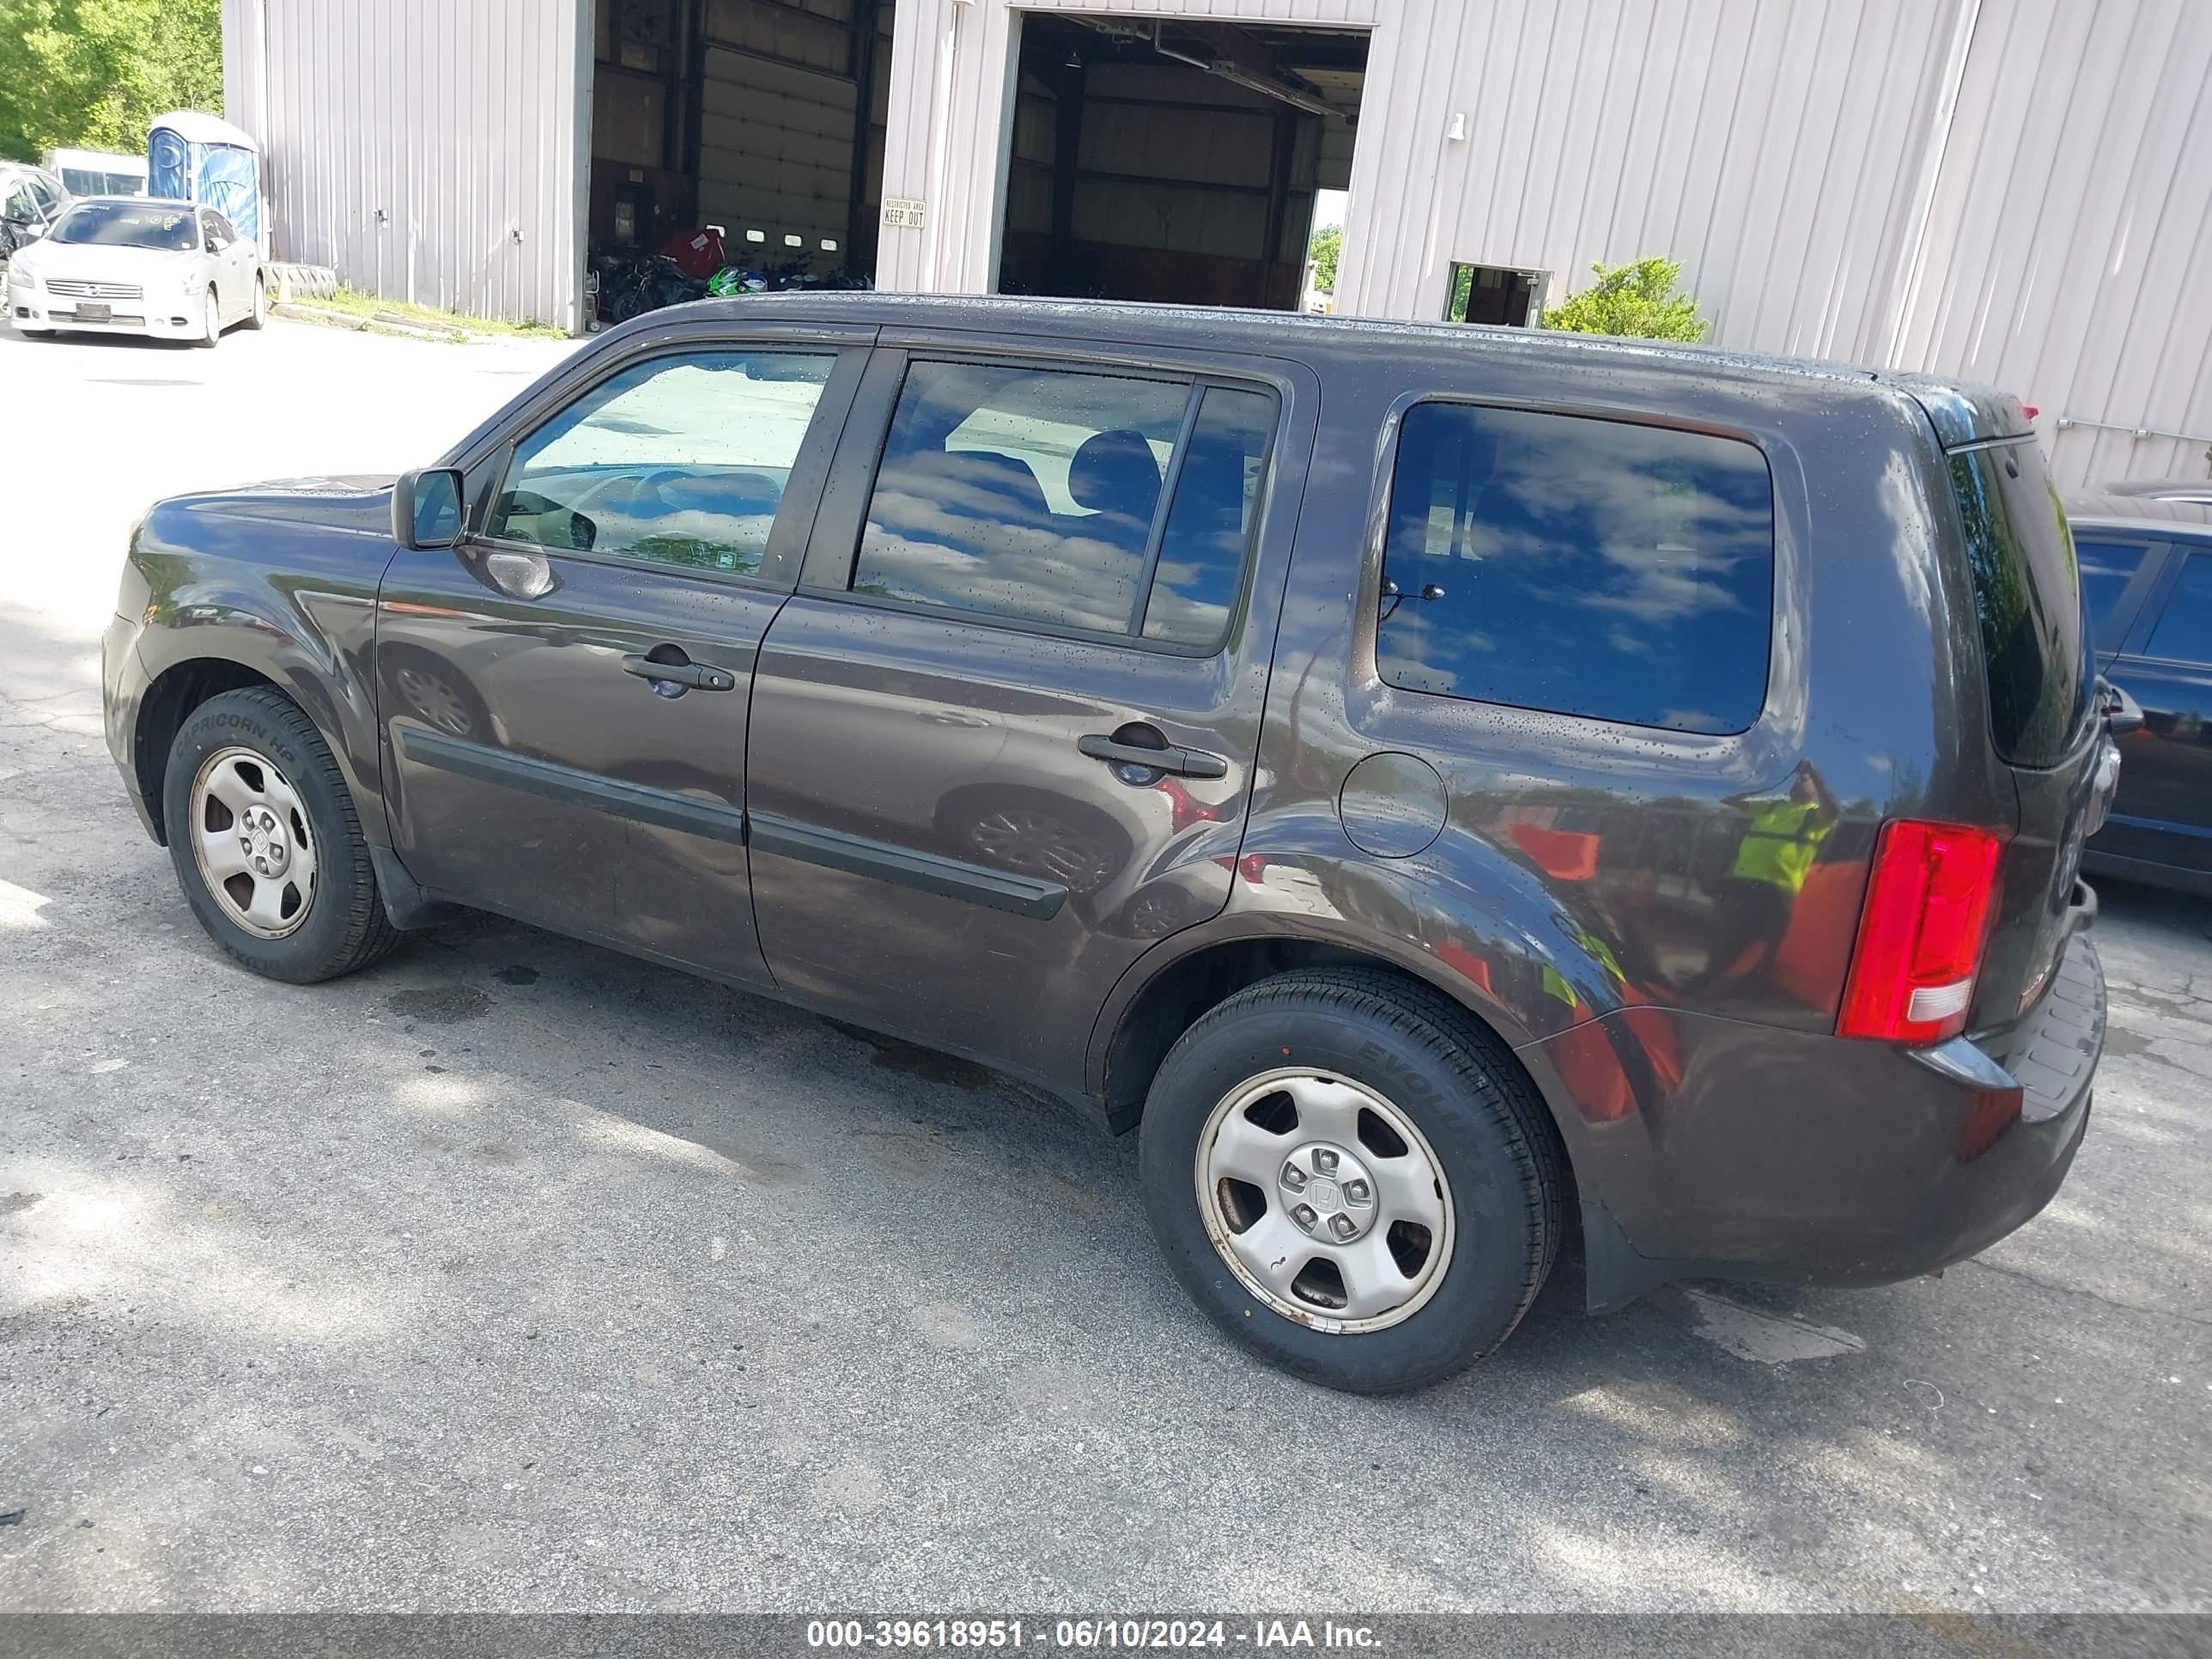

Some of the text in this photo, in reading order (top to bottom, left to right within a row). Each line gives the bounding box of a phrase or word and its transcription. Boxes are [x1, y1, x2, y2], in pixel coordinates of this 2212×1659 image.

[886, 200, 924, 211] RESTRICTED AREA
[885, 209, 924, 226] KEEP OUT
[174, 712, 296, 763] CAPRICORN HP
